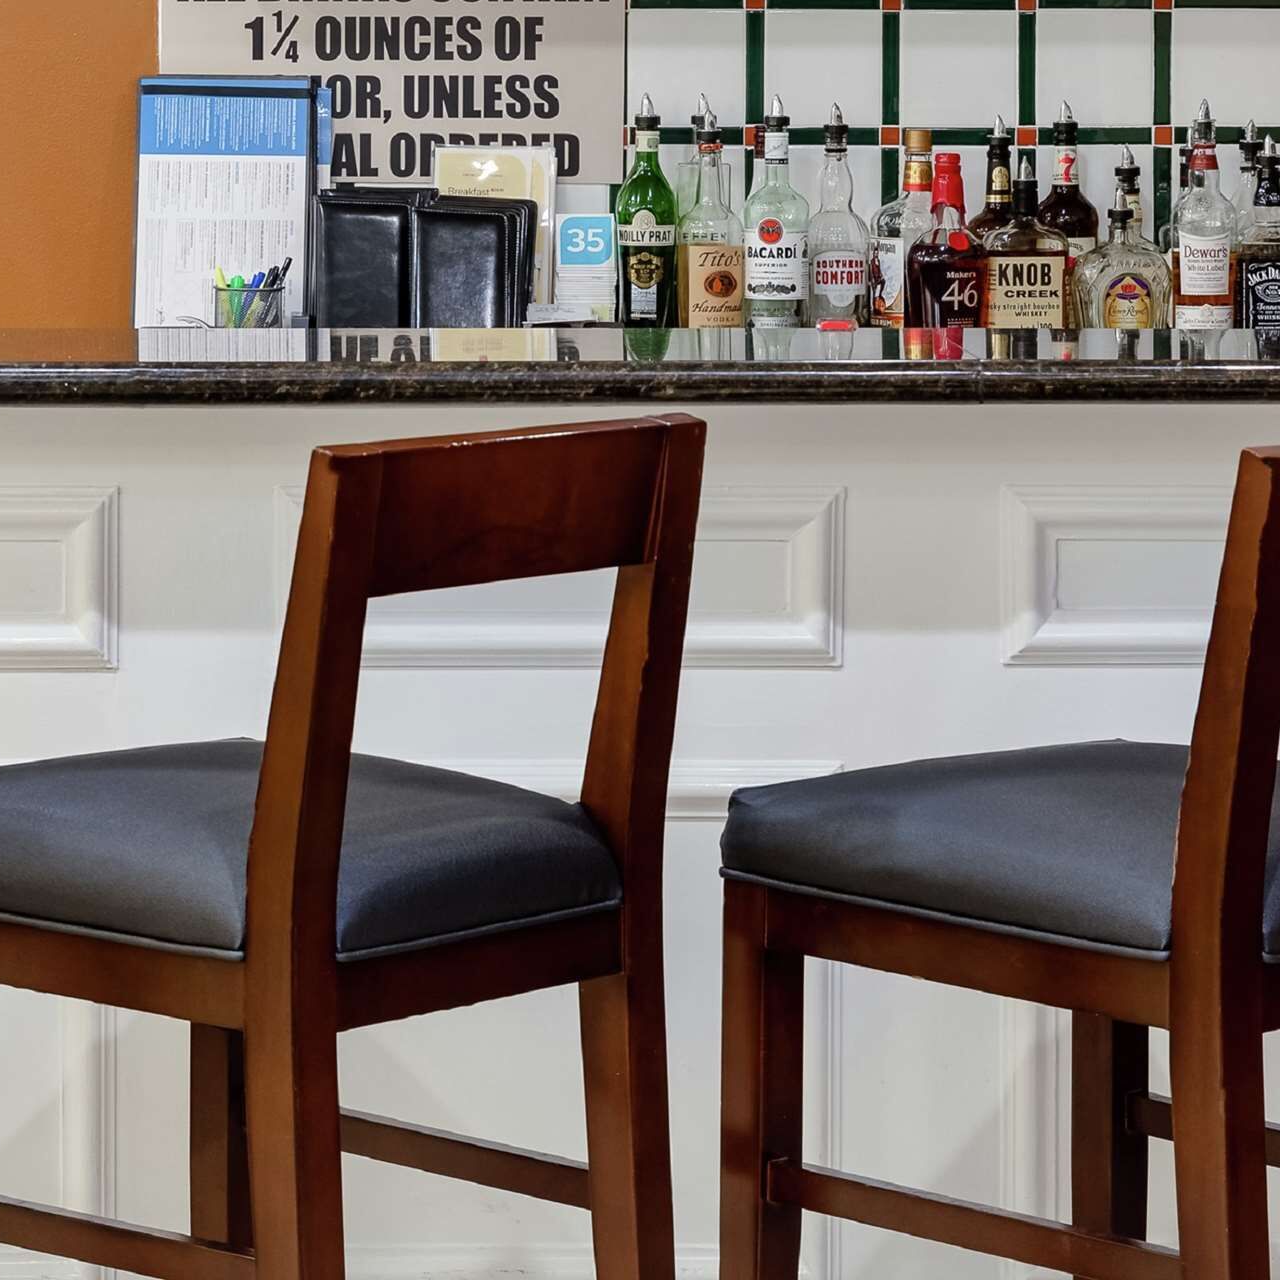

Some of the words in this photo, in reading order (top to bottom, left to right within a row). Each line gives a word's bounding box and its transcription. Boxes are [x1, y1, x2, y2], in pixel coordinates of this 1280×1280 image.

[315, 15, 483, 62] OUNCES
[494, 15, 545, 62] OF
[403, 74, 561, 120] UNLESS
[447, 187, 490, 196] Breakfast
[567, 228, 606, 253] 35
[648, 230, 672, 242] PRAT
[697, 250, 741, 268] Tito's
[747, 244, 798, 259] BACARDÍ
[1184, 246, 1228, 258] Dewar's
[816, 260, 864, 268] SOUTHERN
[816, 271, 865, 286] COMFORT
[998, 263, 1052, 287] KNOB
[1247, 270, 1269, 286] JACK
[941, 280, 978, 310] 46
[1003, 290, 1060, 298] CREEK
